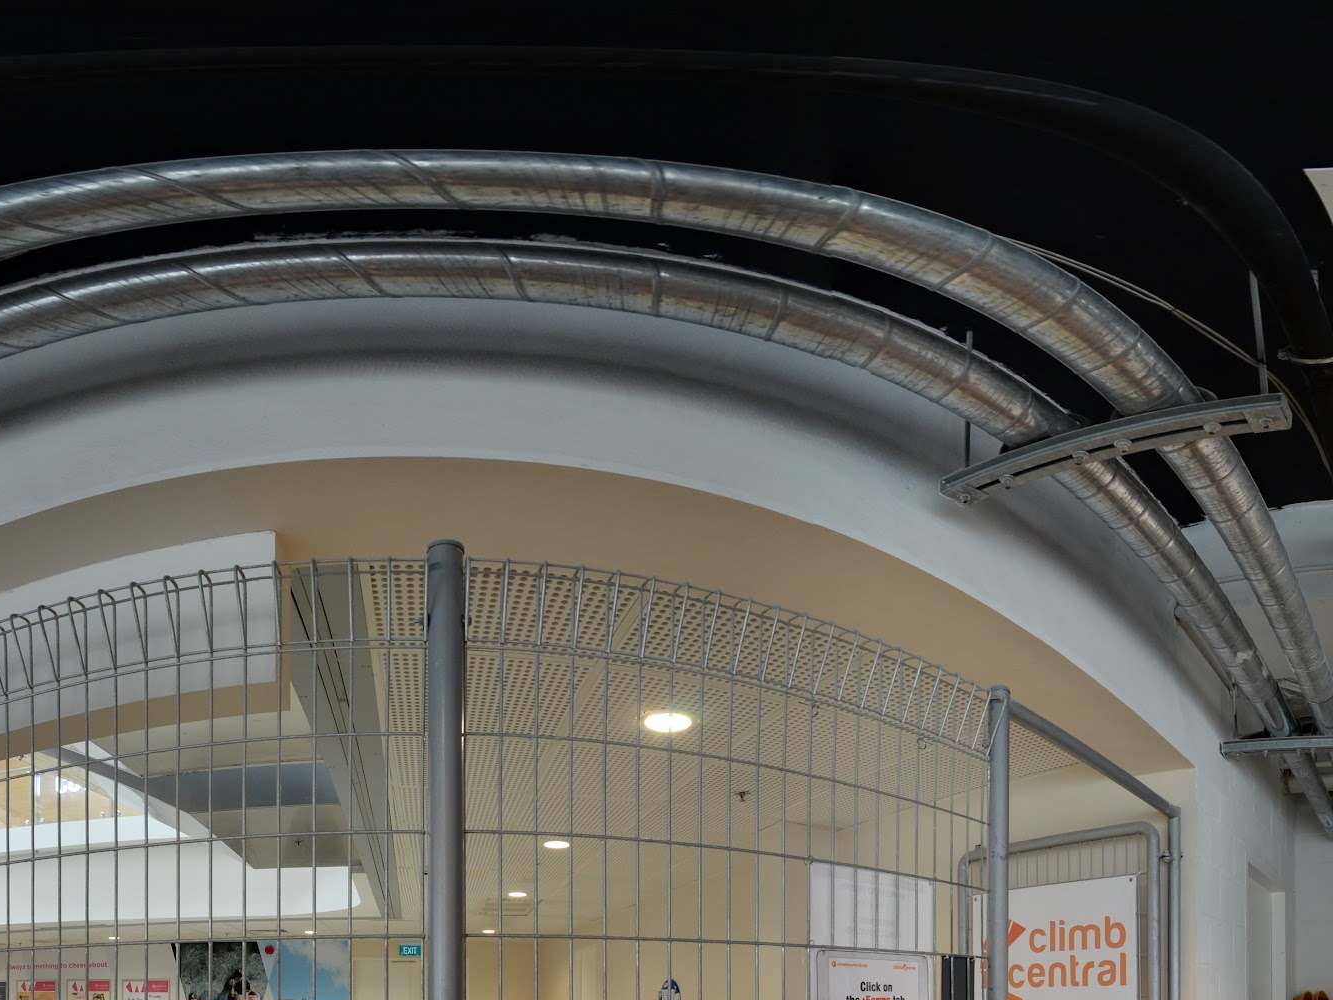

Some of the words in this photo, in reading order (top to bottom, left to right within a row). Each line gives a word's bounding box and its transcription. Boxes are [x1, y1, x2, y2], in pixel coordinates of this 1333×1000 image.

[1029, 915, 1127, 953] climb
[402, 946, 417, 955] EXIT
[1008, 952, 1127, 989] central
[860, 982, 881, 992] Click
[883, 983, 893, 992] on
